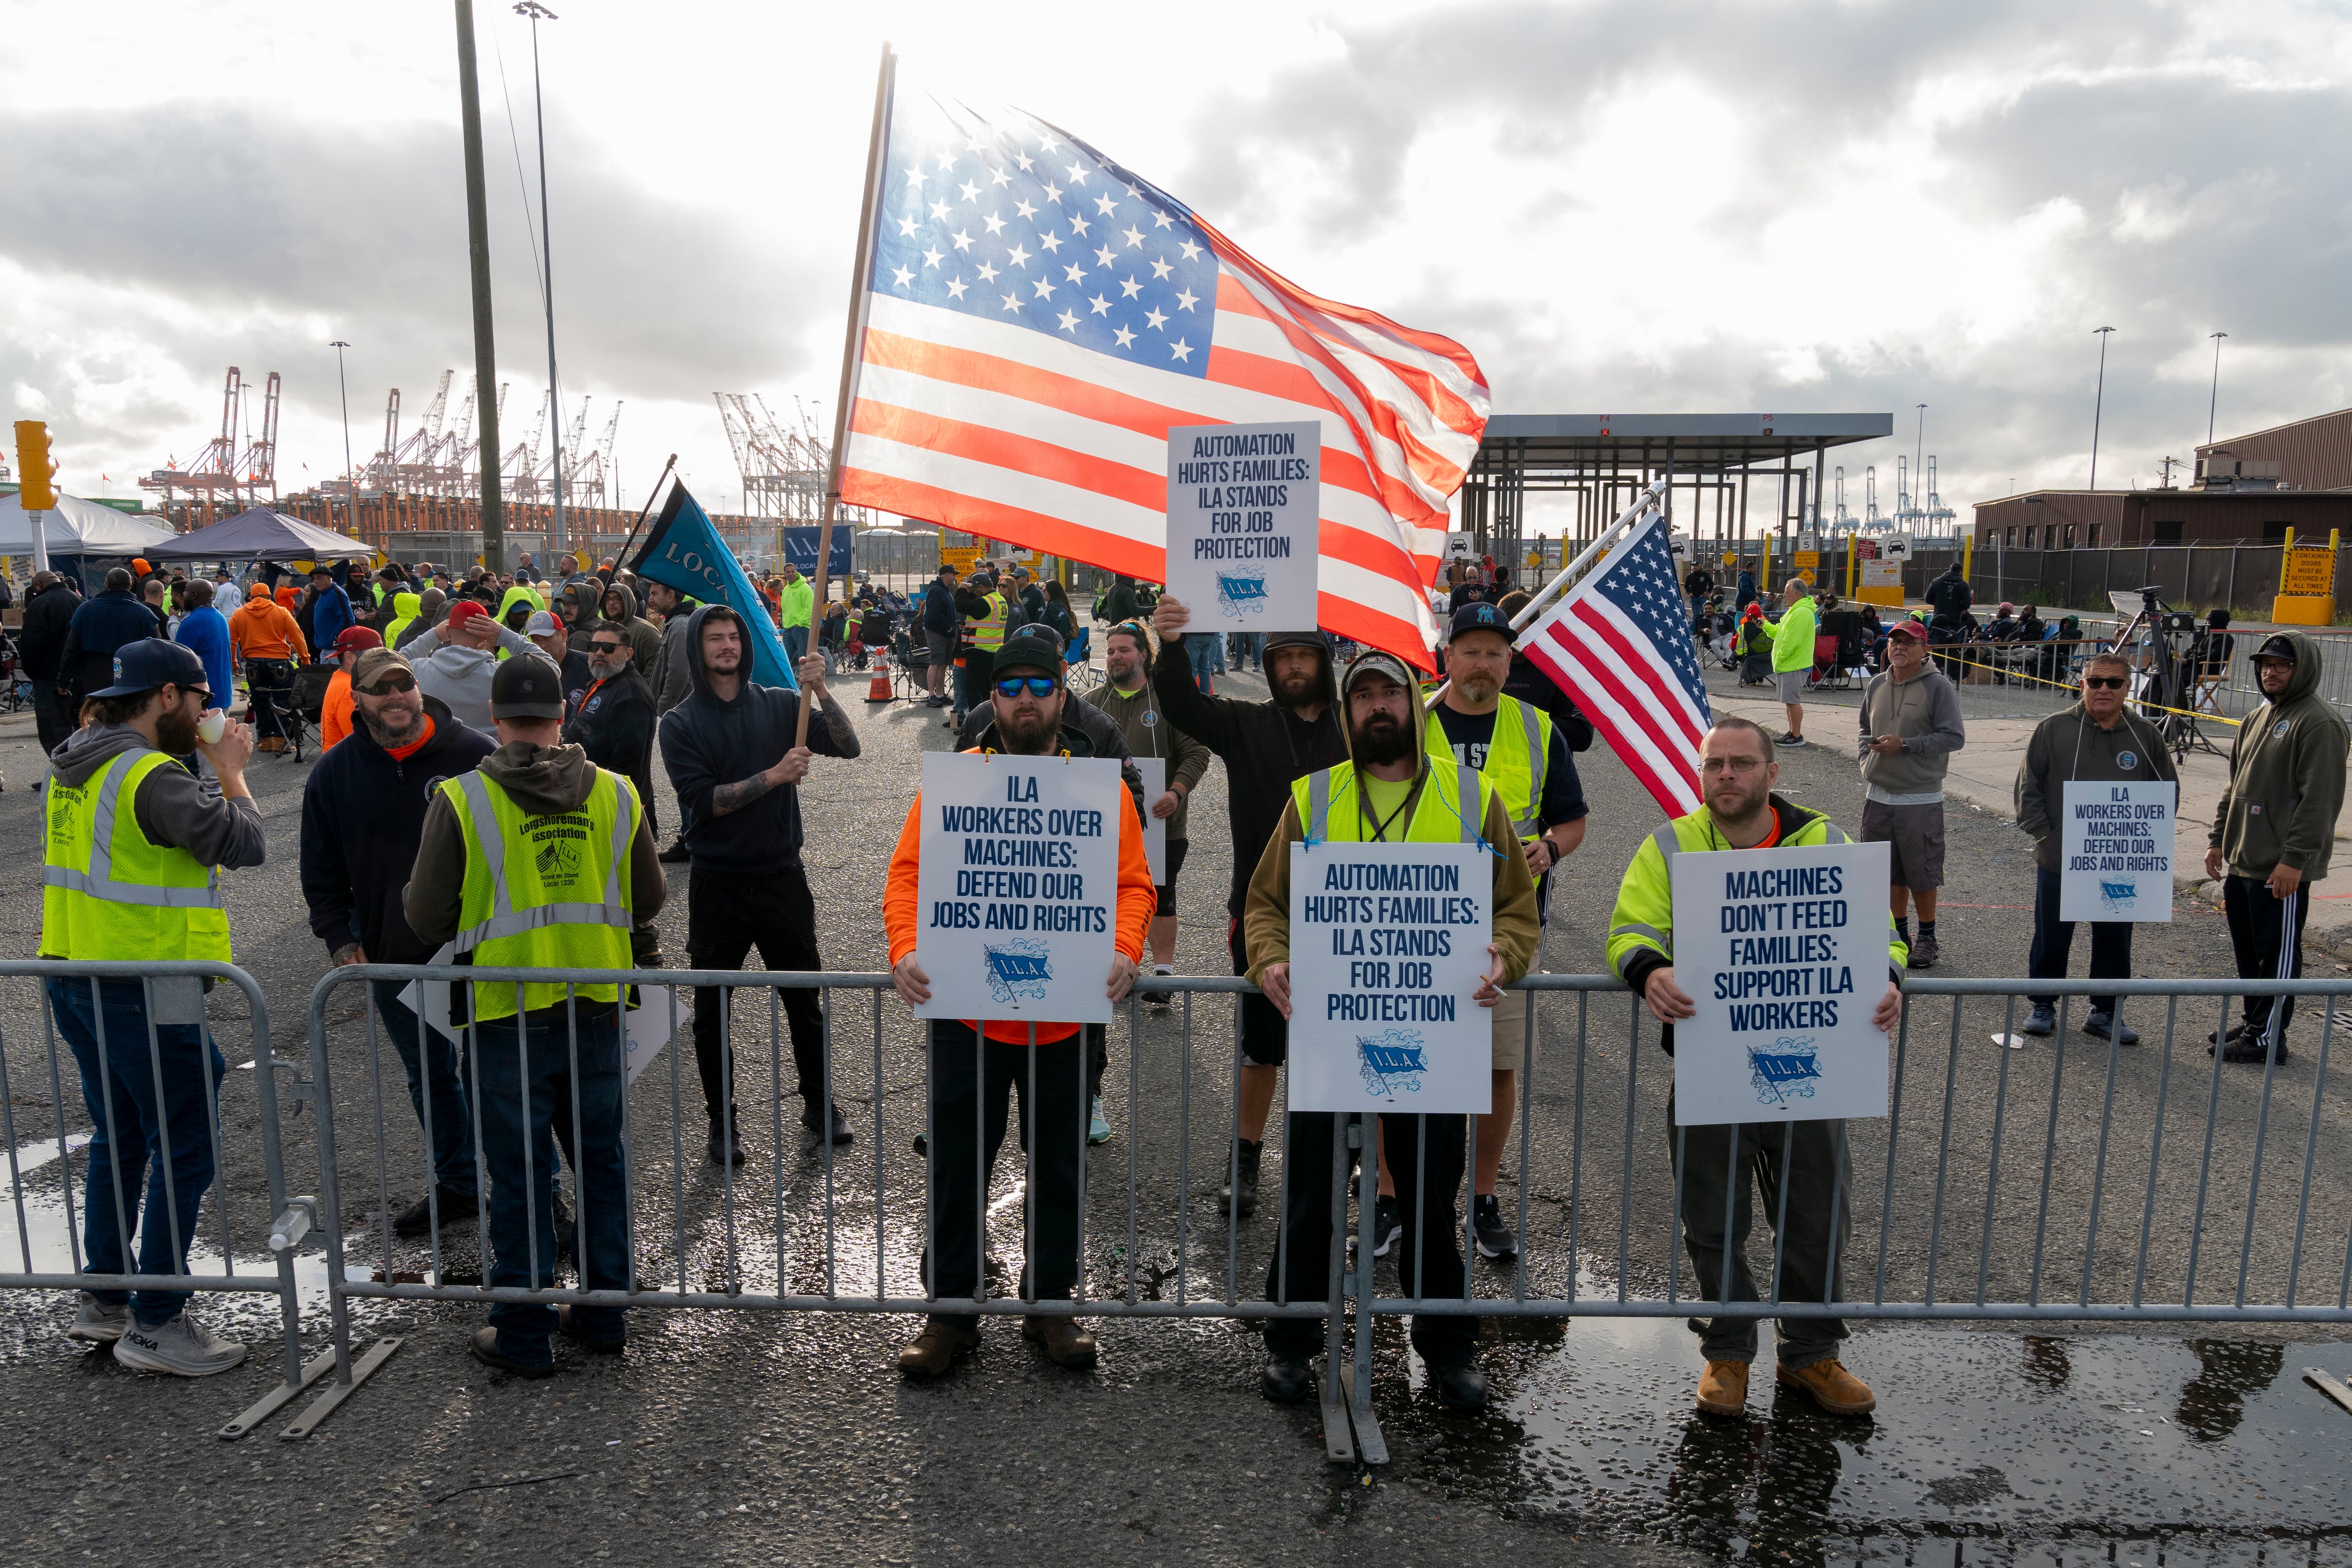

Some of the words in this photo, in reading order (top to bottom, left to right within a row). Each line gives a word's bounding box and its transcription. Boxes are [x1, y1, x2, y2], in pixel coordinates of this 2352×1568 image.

[1193, 433, 1295, 458] AUTOMATION
[1178, 461, 1229, 484] HURTS
[1233, 458, 1310, 482] FAMILIES:
[1199, 487, 1223, 509] ILA
[1226, 485, 1287, 508] STANDS
[1212, 512, 1241, 534] FOR
[1245, 511, 1273, 533] JOB
[1194, 536, 1290, 559] PROTECTION
[664, 541, 729, 603] LOCA
[1229, 581, 1263, 596] I.L.A.
[1007, 775, 1039, 803] ILA
[2112, 787, 2130, 802] ILA
[942, 805, 1043, 835] WORKERS
[1048, 809, 1102, 837] OVER
[2075, 804, 2132, 819] WORKERS
[2135, 804, 2165, 819] OVER
[2088, 821, 2151, 836] MACHINES:
[562, 847, 578, 863] I.L.A.
[964, 838, 1077, 868] MACHINES:
[2084, 839, 2129, 854] DEFEND
[2131, 839, 2154, 854] OUR
[2069, 856, 2097, 871] JOBS
[2099, 856, 2124, 871] AND
[2127, 856, 2168, 871] RIGHTS
[957, 870, 1037, 899] DEFEND
[1042, 873, 1083, 900] OUR
[1324, 864, 1459, 891] AUTOMATION
[1726, 866, 1843, 899] MACHINES
[2107, 886, 2133, 895] I.L.A.
[930, 901, 980, 929] JOBS
[985, 903, 1028, 930] AND
[1033, 905, 1106, 933] RIGHTS
[1305, 896, 1373, 923] HURTS
[1378, 897, 1479, 924] FAMILIES:
[1721, 903, 1787, 933] DON'T
[1792, 899, 1847, 930] FEED
[1333, 929, 1365, 955] ILA
[1370, 929, 1451, 957] STANDS
[1731, 934, 1837, 966] FAMILIES:
[1001, 959, 1044, 975] I.L.A.
[1351, 961, 1390, 988] FOR
[1395, 962, 1432, 989] JOB
[1714, 968, 1814, 1000] SUPPORT
[1820, 966, 1854, 995] ILA
[1327, 994, 1455, 1022] PROTECTION
[1729, 1000, 1838, 1032] WORKERS
[1375, 1051, 1418, 1068] I.L.A.
[1764, 1060, 1812, 1075] I.L.A.
[124, 1330, 159, 1351] HOKA
